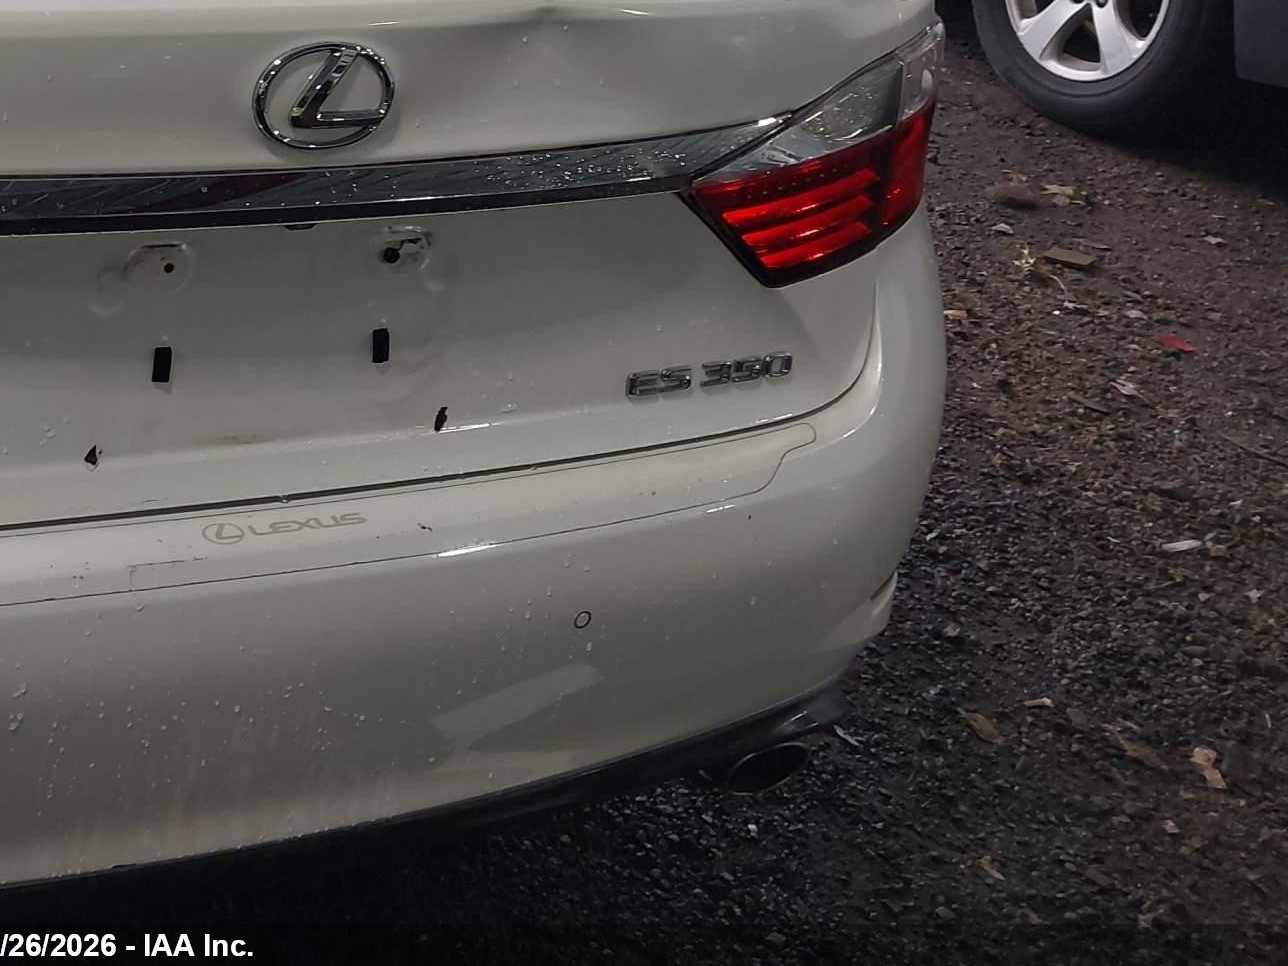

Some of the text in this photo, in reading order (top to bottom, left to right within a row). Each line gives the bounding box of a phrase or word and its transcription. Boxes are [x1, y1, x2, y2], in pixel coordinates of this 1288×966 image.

[625, 351, 793, 397] ES 350
[247, 513, 367, 536] LEXUS
